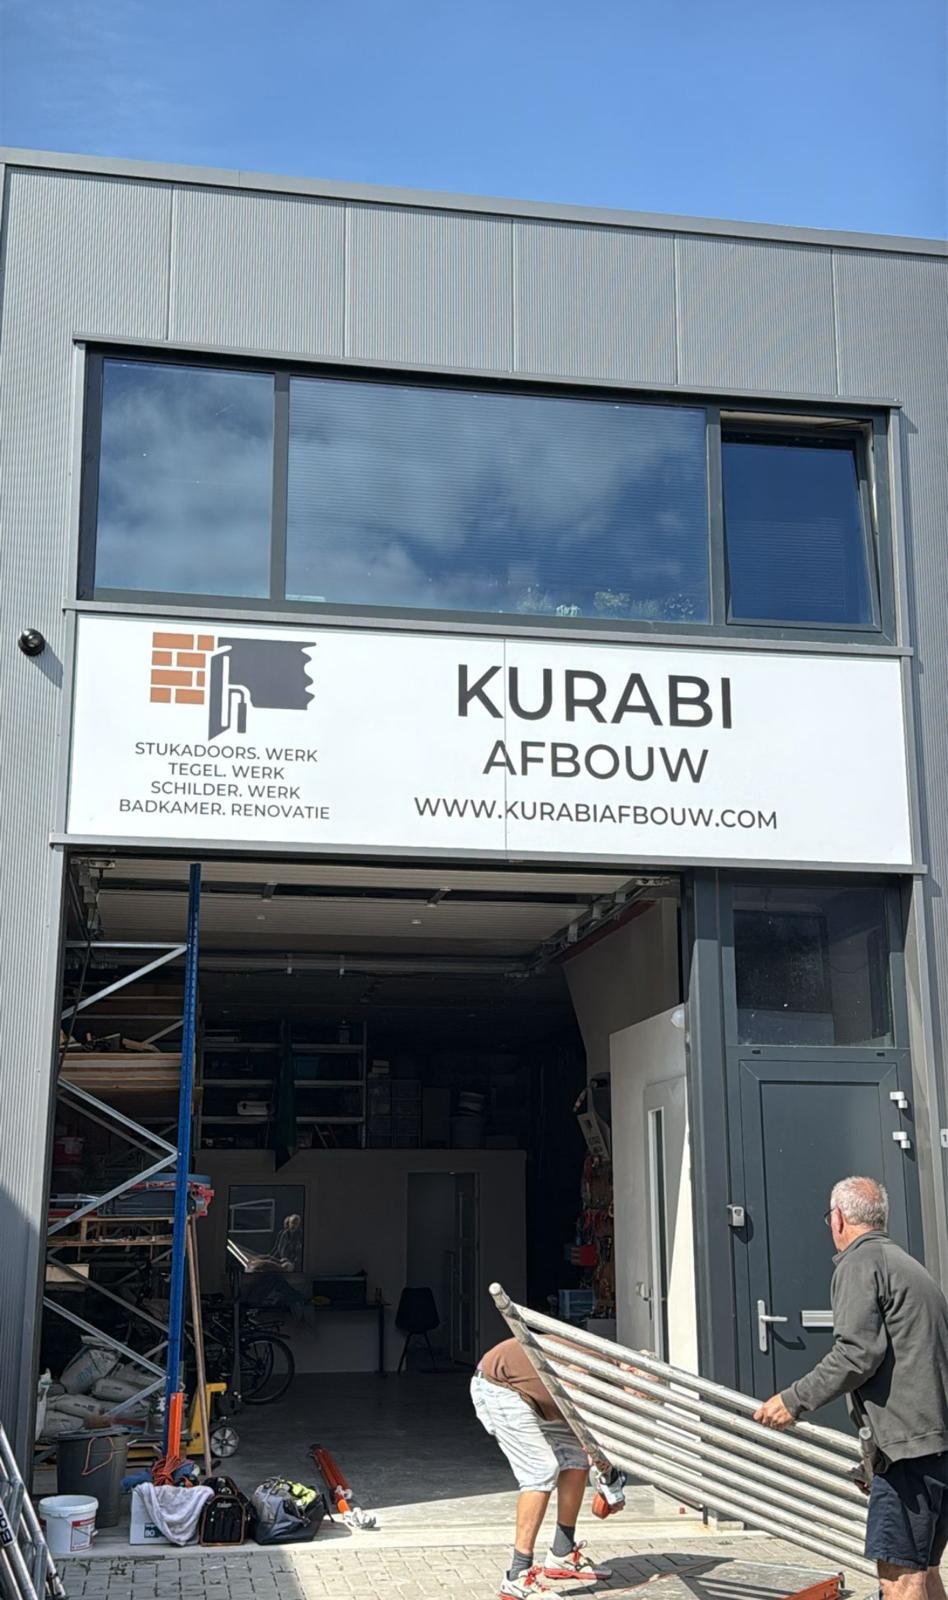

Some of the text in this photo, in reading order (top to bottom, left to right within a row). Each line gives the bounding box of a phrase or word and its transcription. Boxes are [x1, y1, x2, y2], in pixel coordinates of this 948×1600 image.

[458, 663, 732, 730] KURABI
[135, 742, 318, 762] STUKADOORS. WERK
[482, 740, 709, 783] AFBOUW
[168, 762, 285, 780] TEGEL. WERK
[150, 780, 300, 799] SCHILDER. WERK
[119, 799, 330, 820] BADKAMER. RENOVATIE
[414, 797, 777, 829] WWW.KURABIAFBOUW.COM
